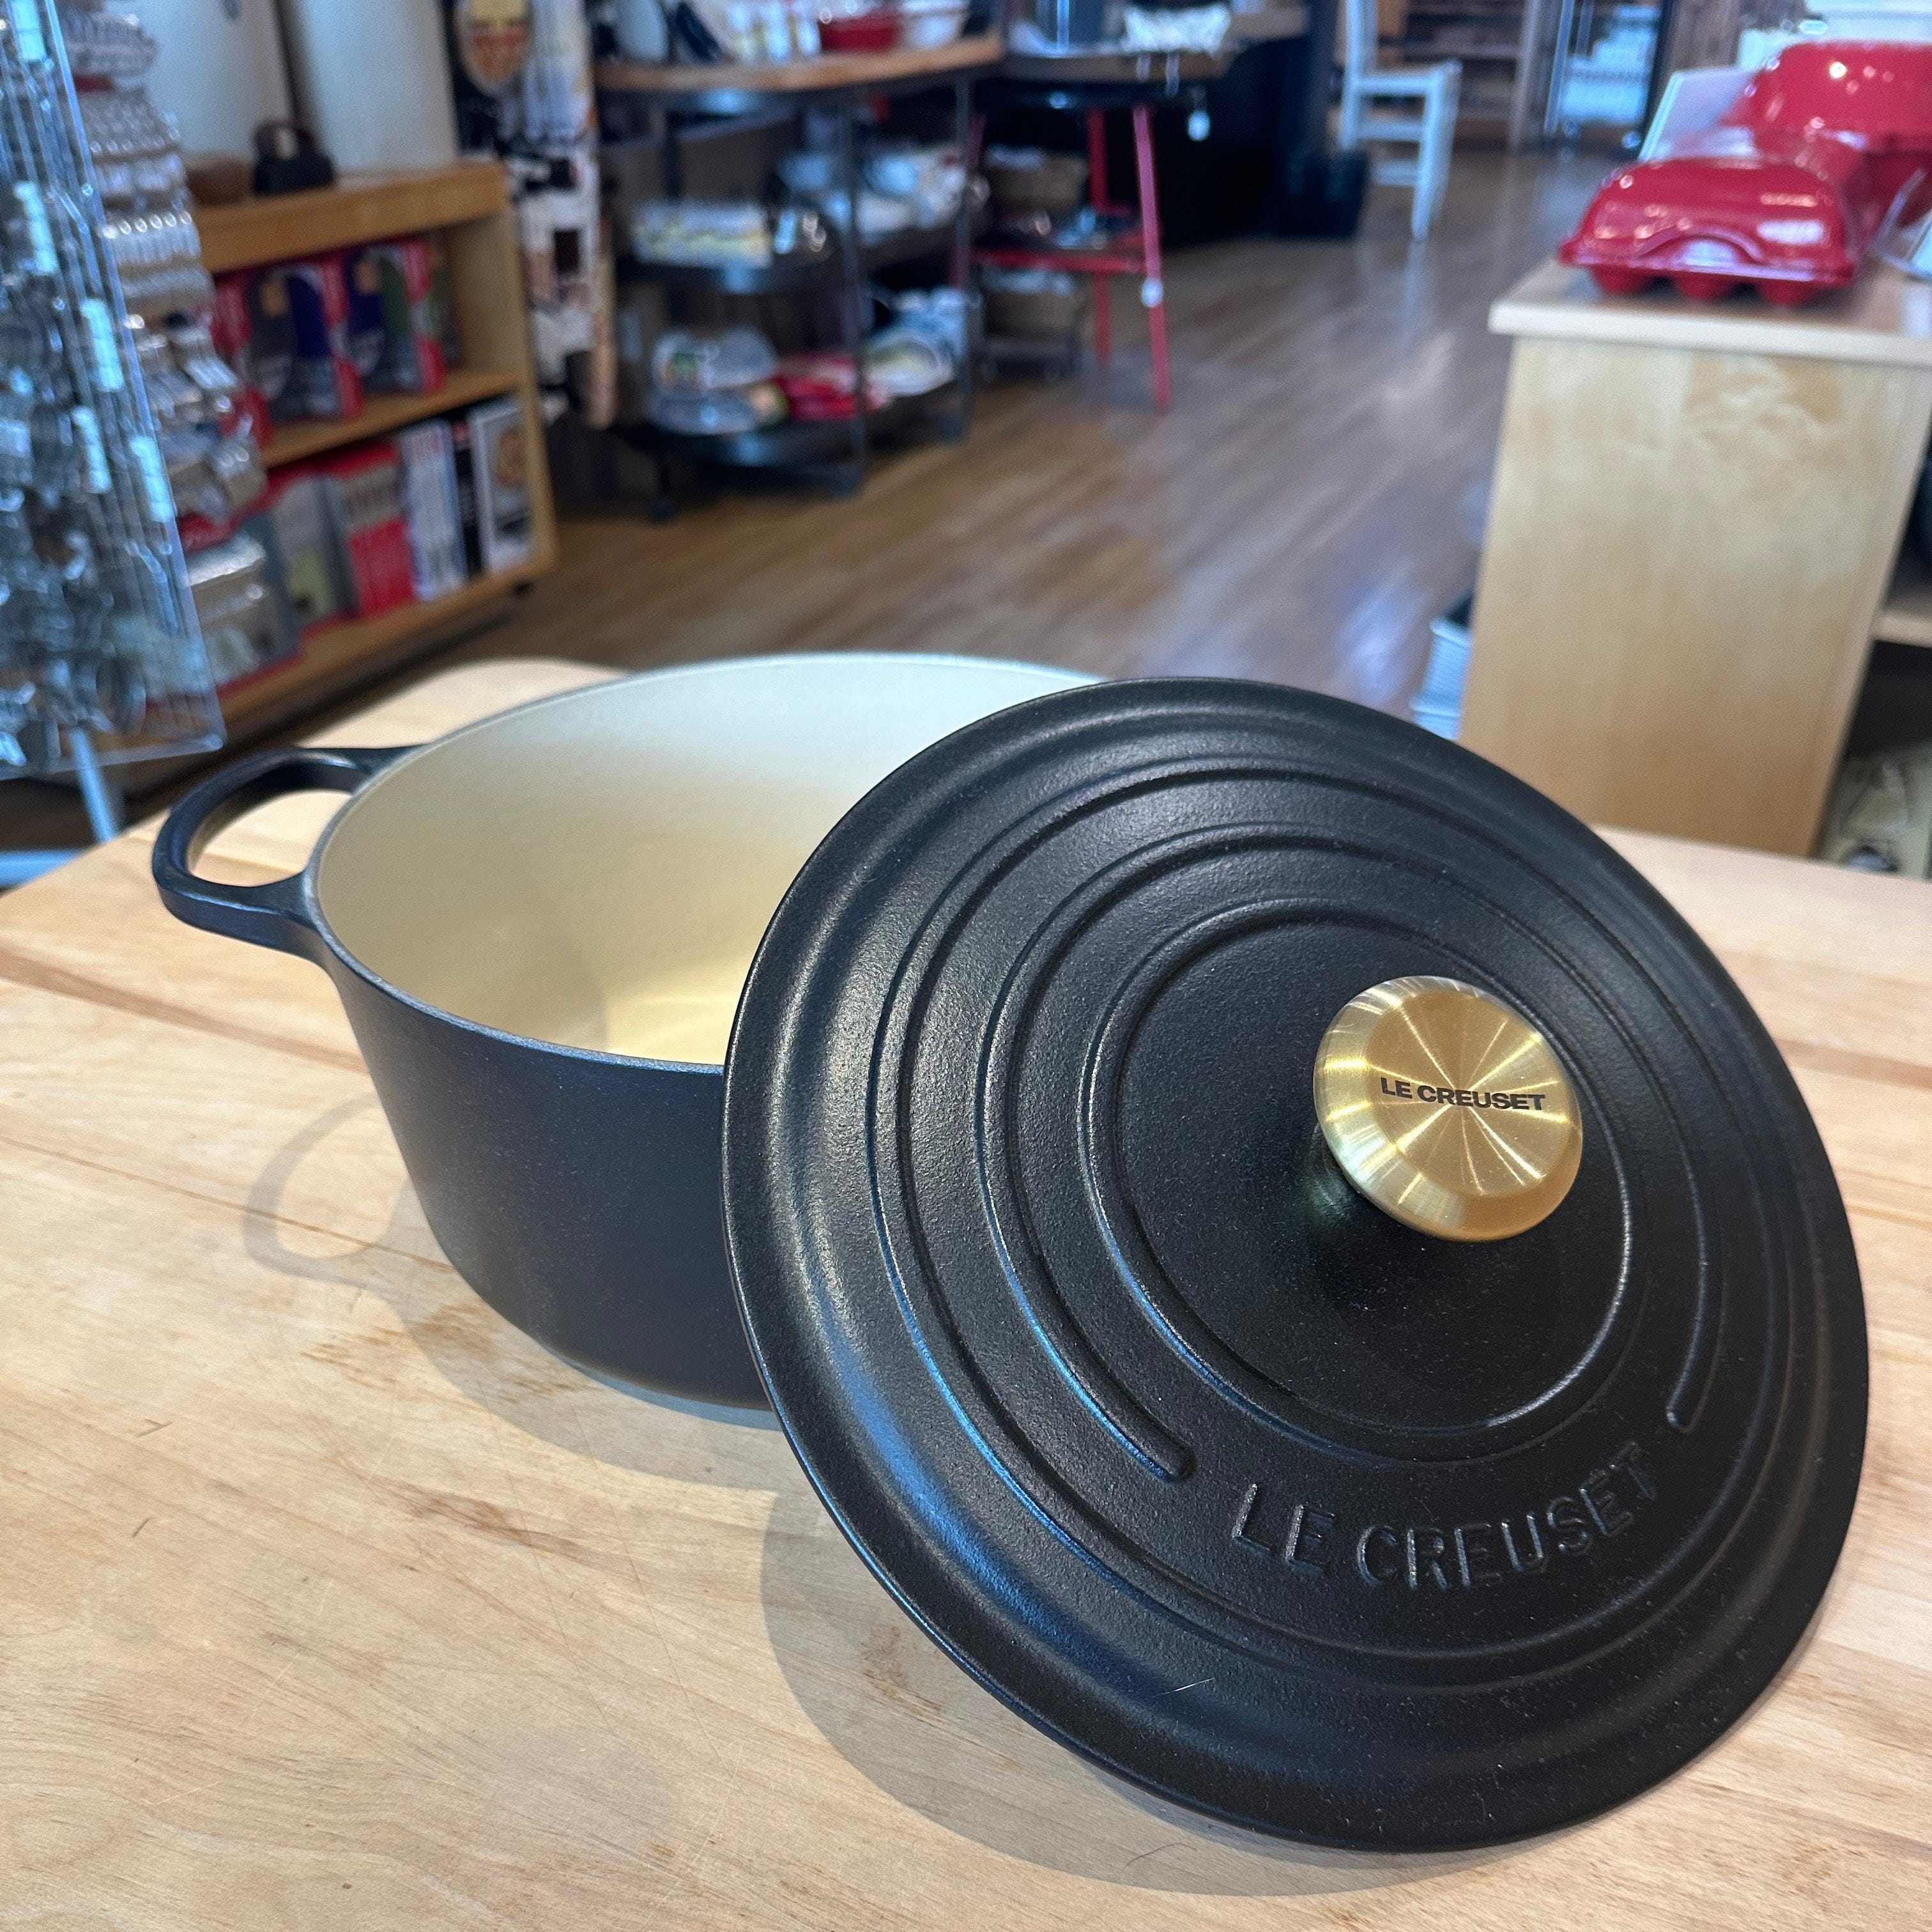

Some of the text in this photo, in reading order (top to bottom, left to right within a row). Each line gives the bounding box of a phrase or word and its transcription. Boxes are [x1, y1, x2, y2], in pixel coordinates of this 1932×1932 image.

[1381, 1077, 1545, 1110] LE CREUSET
[1231, 1440, 1656, 1591] LE CREUSET
